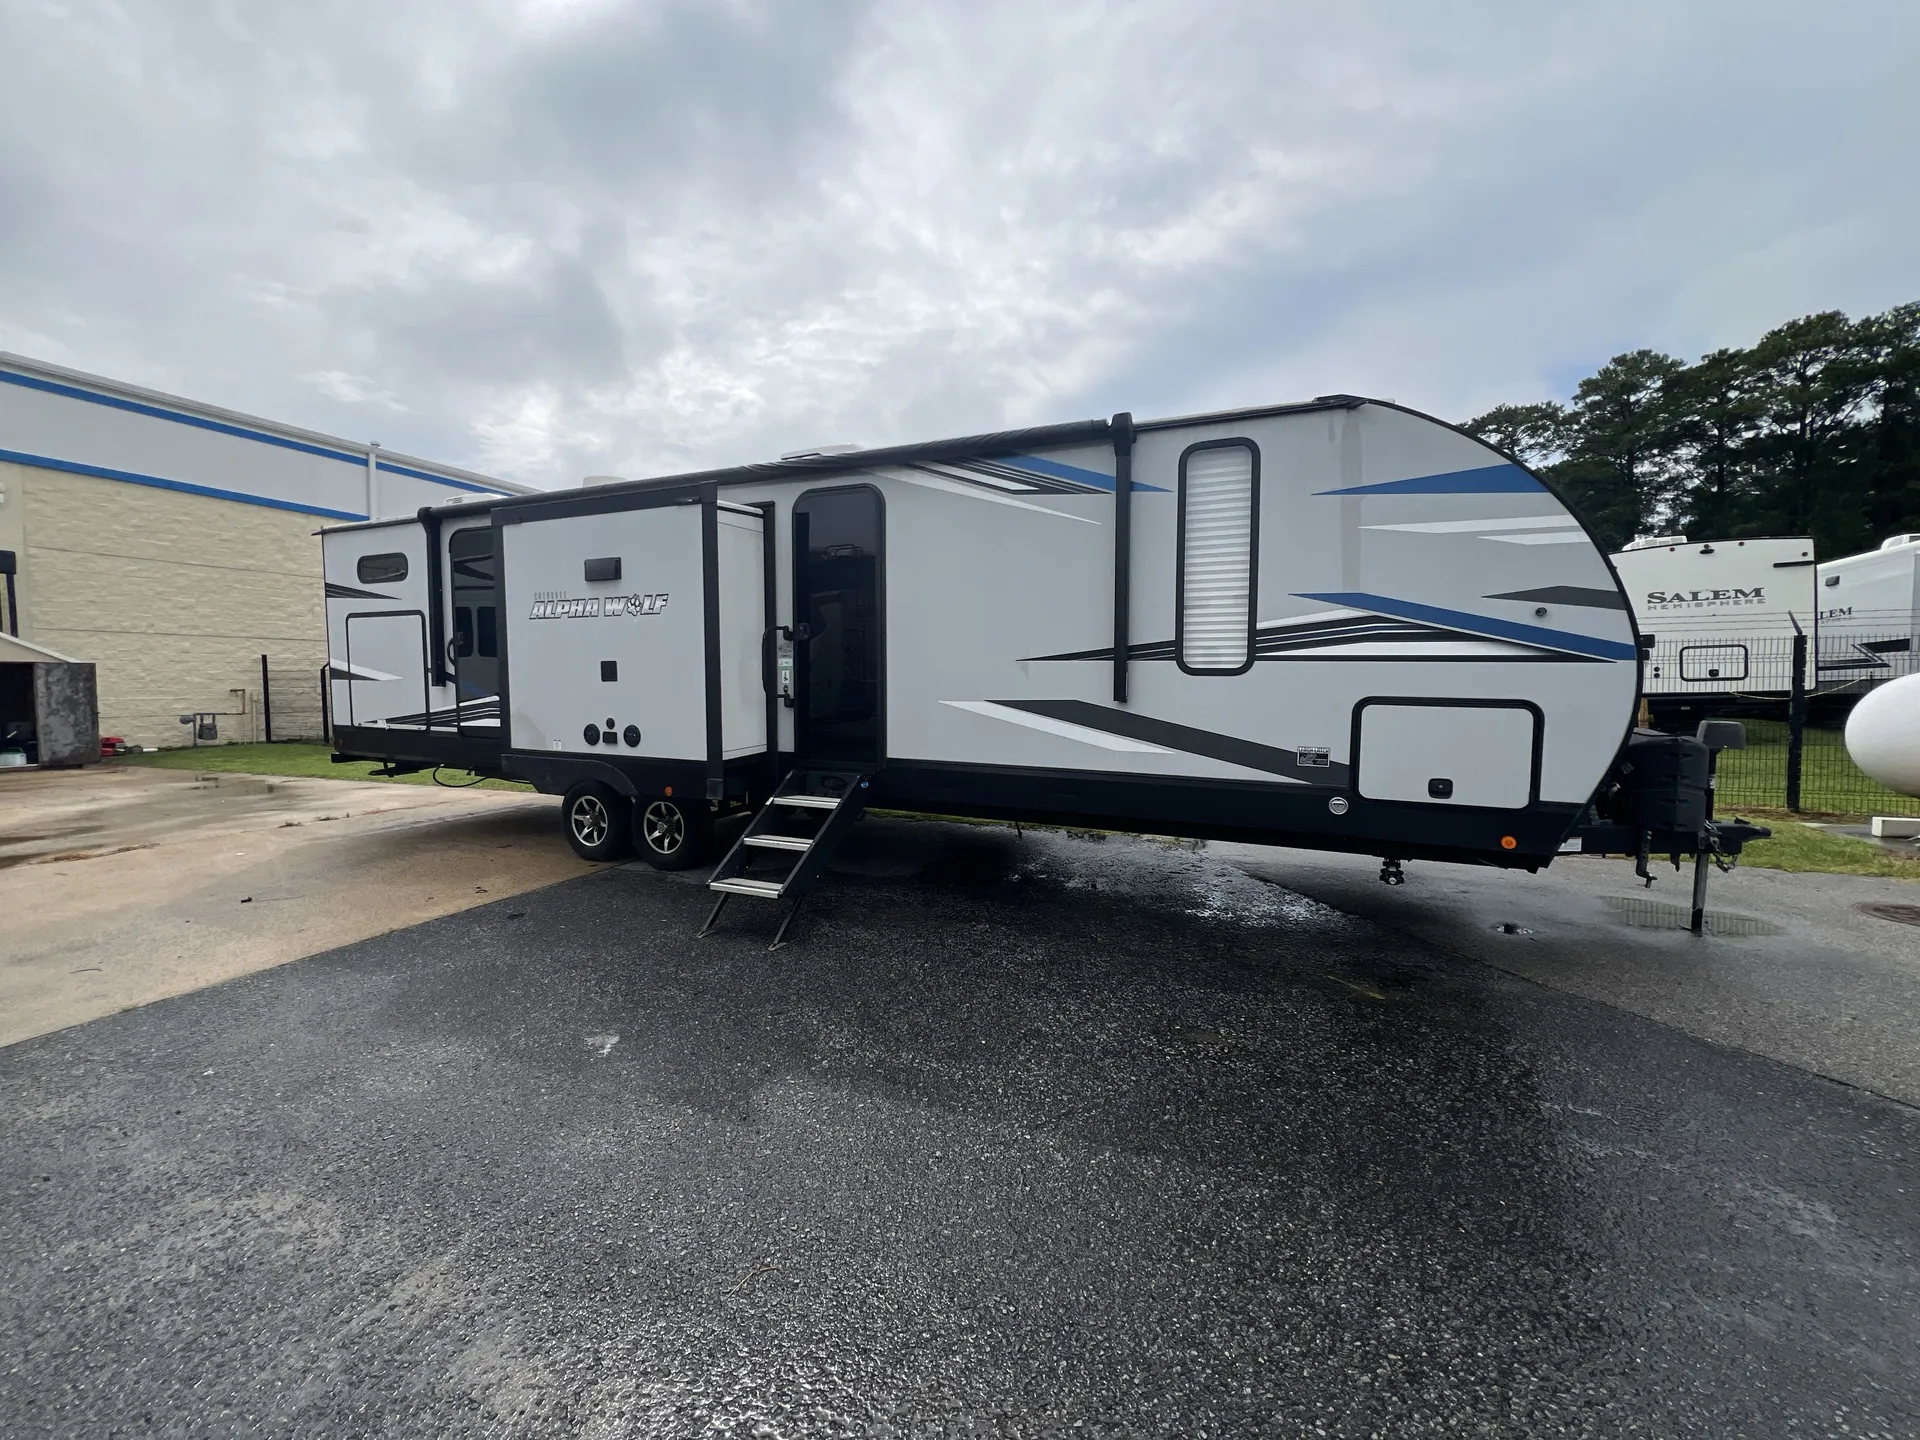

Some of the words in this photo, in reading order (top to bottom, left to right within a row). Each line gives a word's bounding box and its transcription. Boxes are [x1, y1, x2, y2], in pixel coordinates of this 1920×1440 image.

[1647, 587, 1764, 604] SALEM
[529, 598, 599, 620] ALPHA
[1647, 598, 1766, 611] HEMISPHERE
[1820, 606, 1853, 620] LEM
